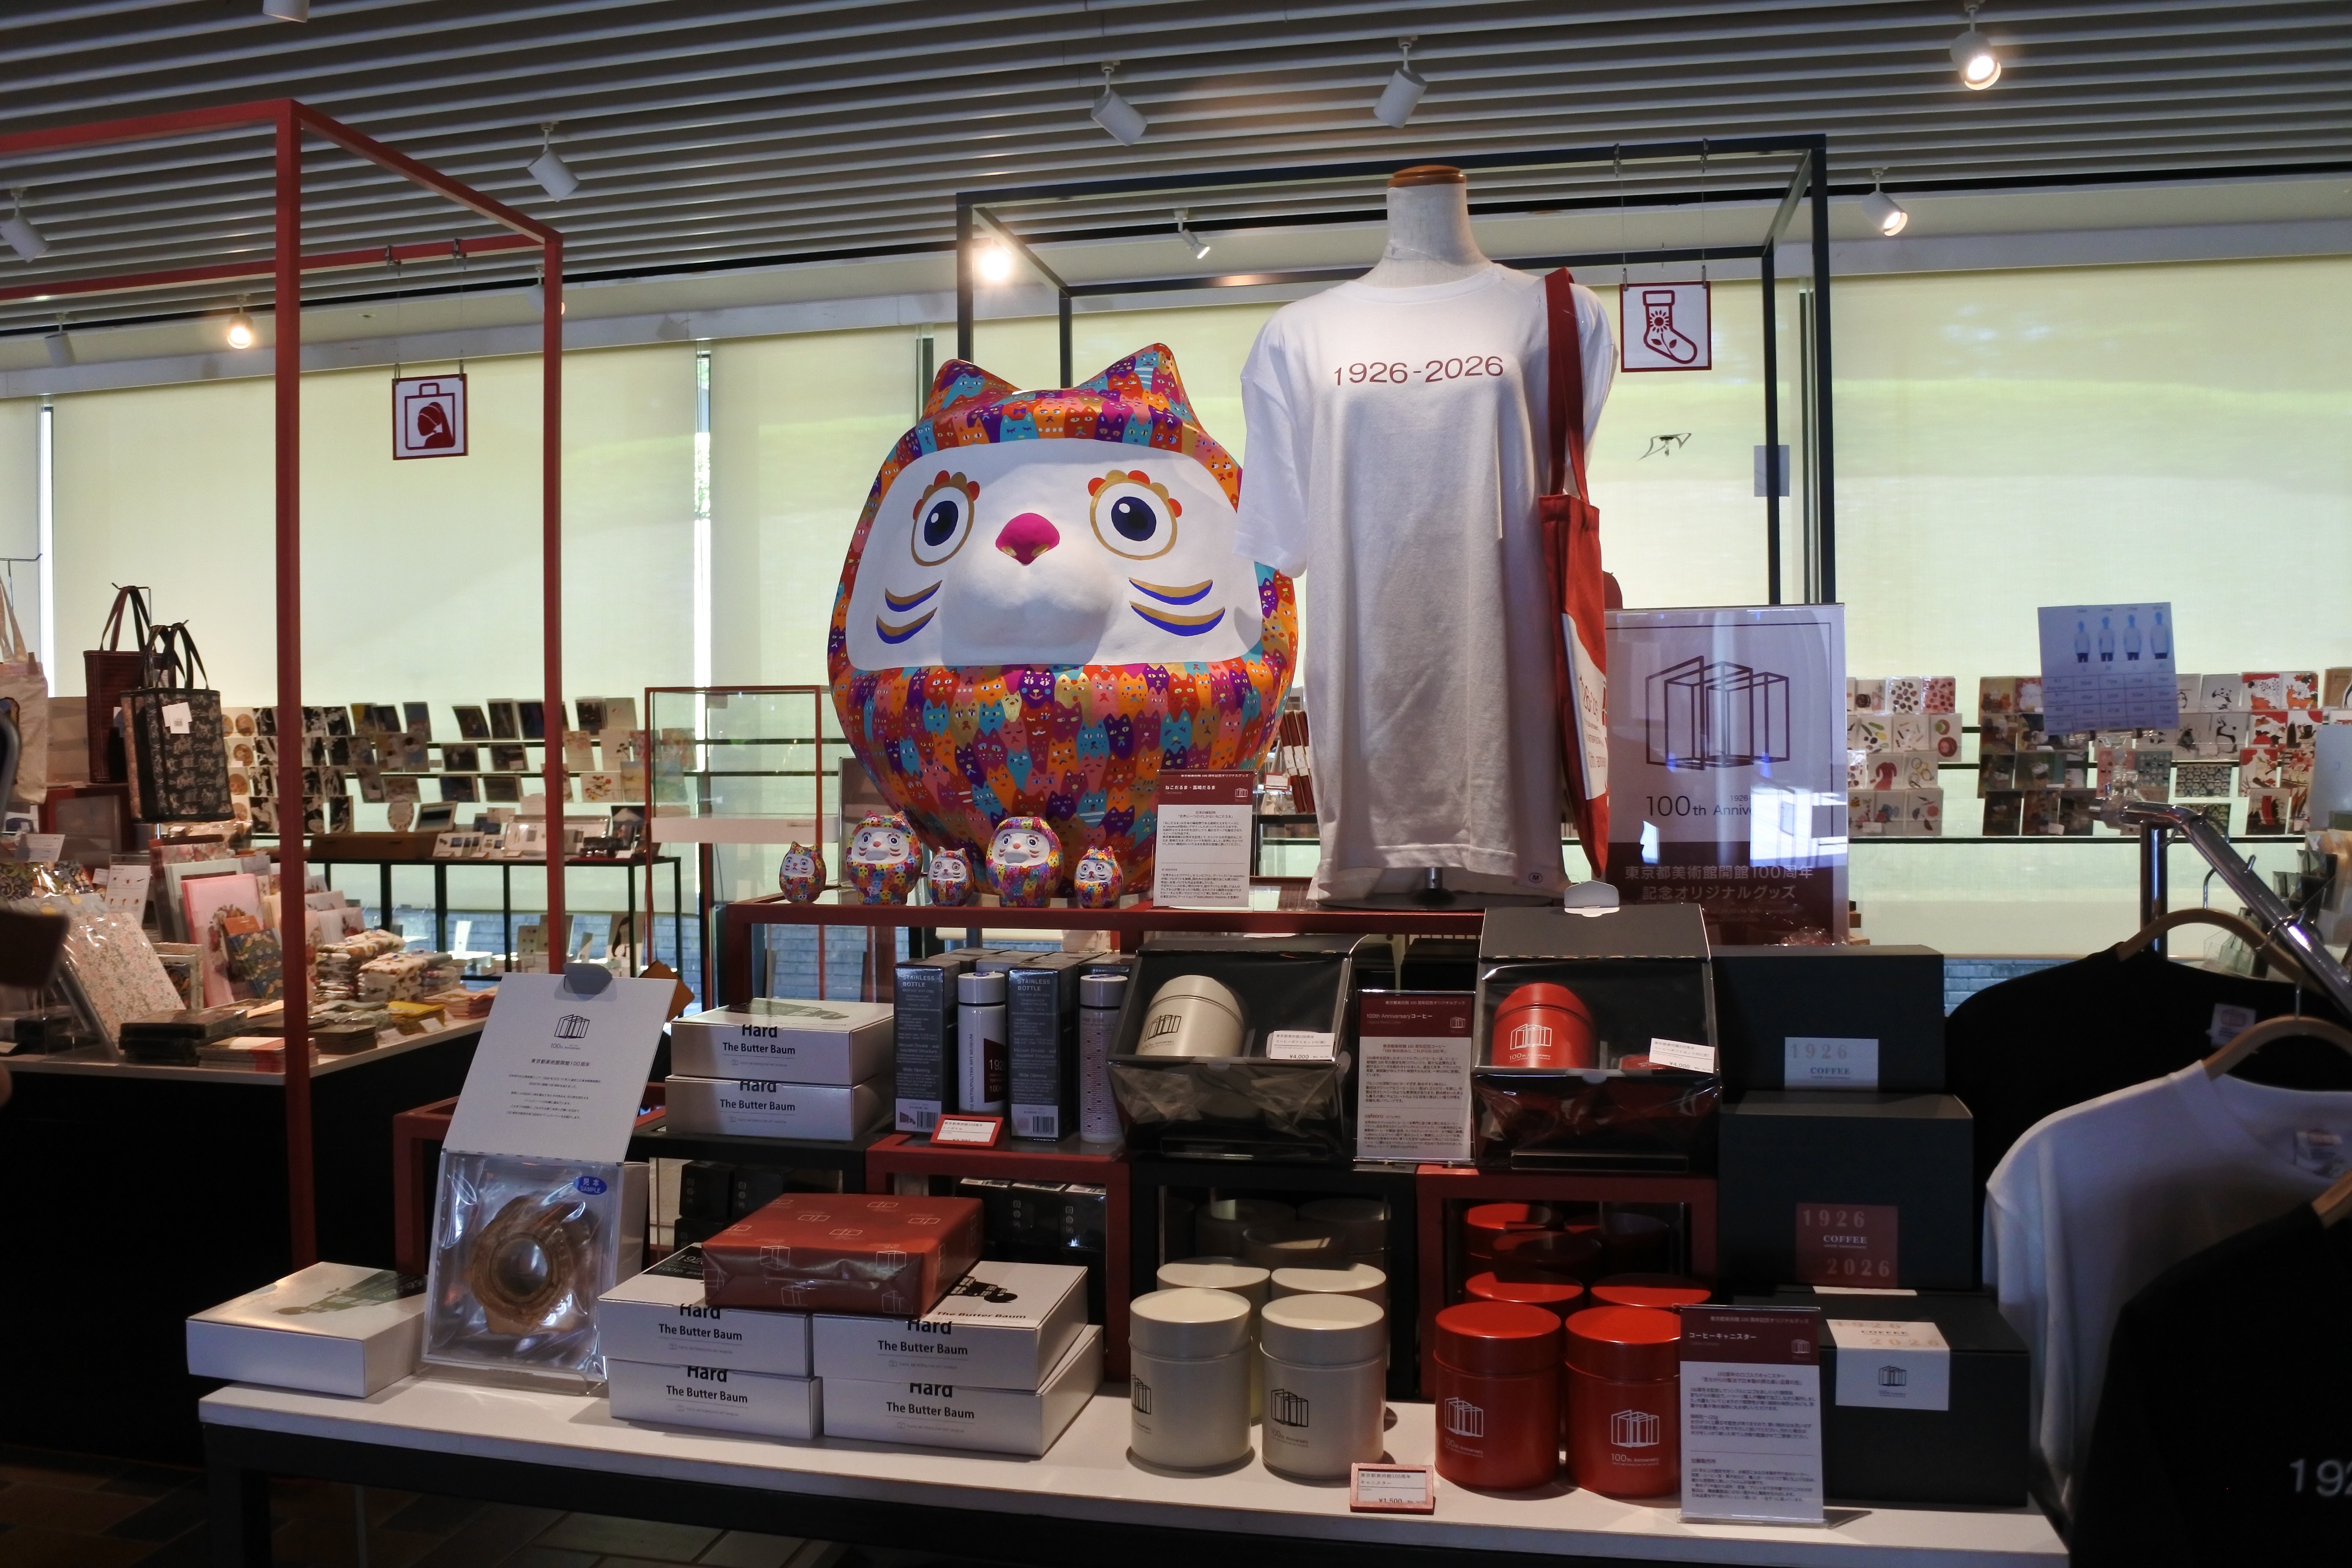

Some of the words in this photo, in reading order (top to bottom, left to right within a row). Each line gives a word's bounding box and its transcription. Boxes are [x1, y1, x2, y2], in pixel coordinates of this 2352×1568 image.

[1334, 356, 1503, 386] 1926-2026
[1625, 866, 1813, 880] 東京都美術館開館100周年
[1643, 885, 1796, 900] 記念オリジナルグッズ
[723, 1042, 738, 1052] The
[741, 1043, 768, 1054] Butter
[770, 1045, 795, 1055] Baum
[1810, 1067, 1851, 1075] COFFEE
[720, 1099, 736, 1109] The
[739, 1100, 767, 1111] Butter
[770, 1101, 795, 1112] Baum
[580, 1185, 601, 1194] SAMPLE
[583, 1178, 600, 1187] 見本
[1802, 1209, 1865, 1228] 1926
[1823, 1234, 1867, 1244] COFFEE
[677, 1255, 703, 1265] 192
[1827, 1258, 1890, 1277] 2026
[659, 1323, 677, 1335] The
[680, 1325, 711, 1338] Butter
[714, 1328, 743, 1341] Baum
[878, 1340, 898, 1352] The
[900, 1341, 934, 1354] Butter
[937, 1344, 968, 1355] Baum
[666, 1385, 684, 1396] The
[686, 1387, 718, 1400] Butter
[720, 1391, 748, 1403] Baum
[886, 1402, 906, 1413] The
[908, 1403, 942, 1417] Butter
[944, 1406, 975, 1419] Baum
[1612, 1453, 1632, 1462] 100th
